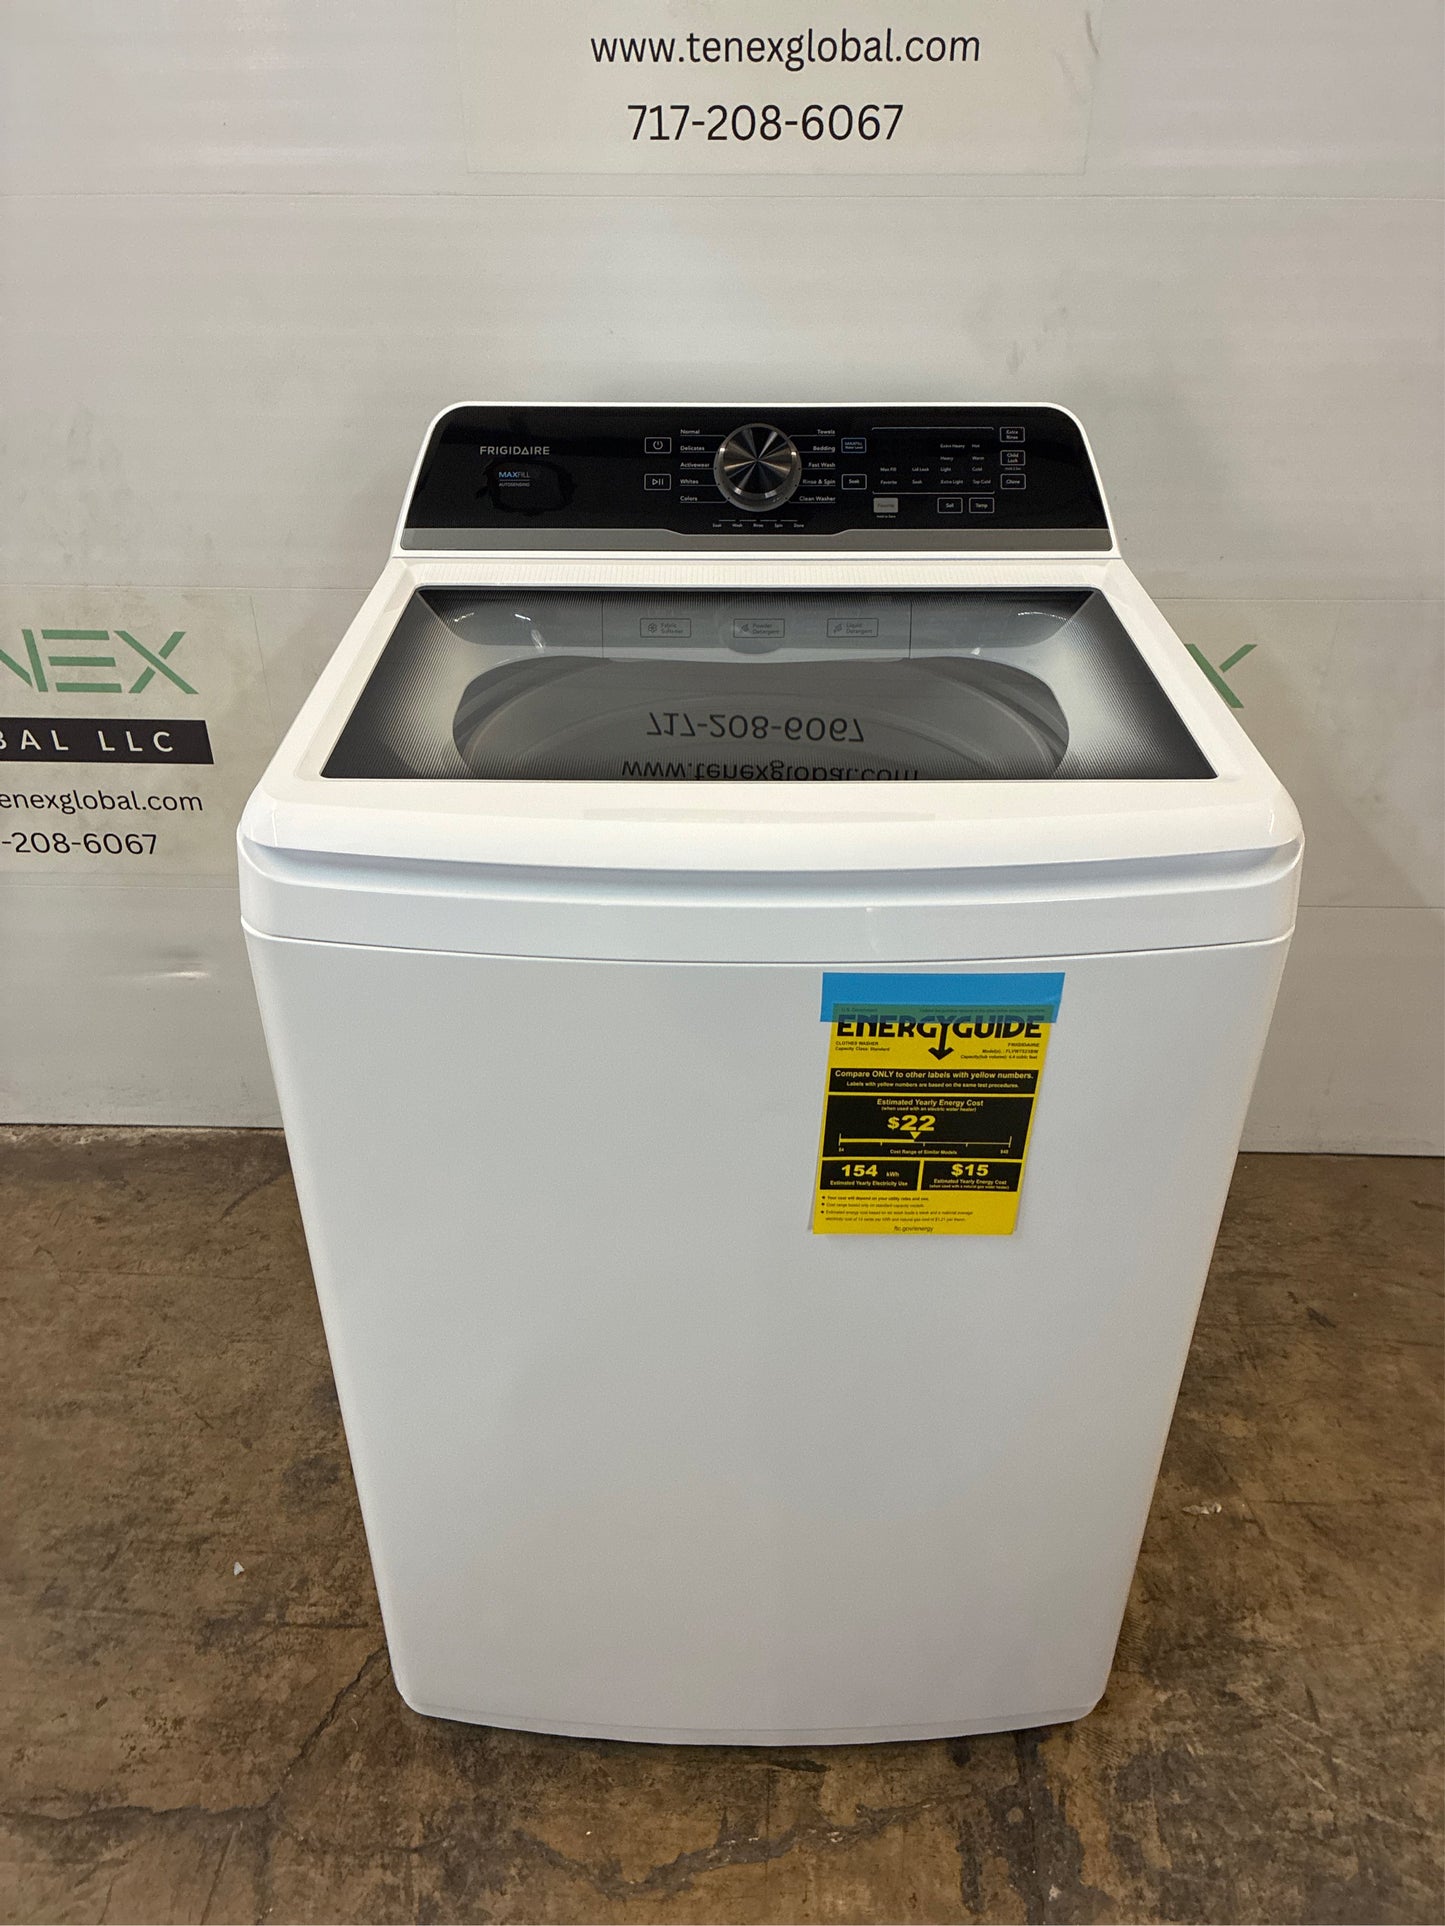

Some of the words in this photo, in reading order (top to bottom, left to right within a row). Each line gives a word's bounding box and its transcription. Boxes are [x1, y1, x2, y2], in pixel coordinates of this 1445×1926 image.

[591, 28, 980, 71] www.tenexglobal.com
[628, 104, 903, 141] 717-208-6067
[479, 446, 550, 455] FRIGIDAIRE
[98, 730, 174, 752] LLC
[837, 1014, 1044, 1039] ENERGYGUIDE
[835, 1070, 870, 1078] Compare
[872, 1070, 894, 1078] ONLY
[896, 1070, 904, 1078] to
[905, 1070, 926, 1078] other
[928, 1070, 951, 1079] labels
[952, 1070, 969, 1079] with
[970, 1070, 996, 1079] yellow
[997, 1070, 1034, 1079] numbers.
[887, 1115, 936, 1131] $22
[842, 1164, 878, 1177] 154
[951, 1163, 989, 1177] $15
